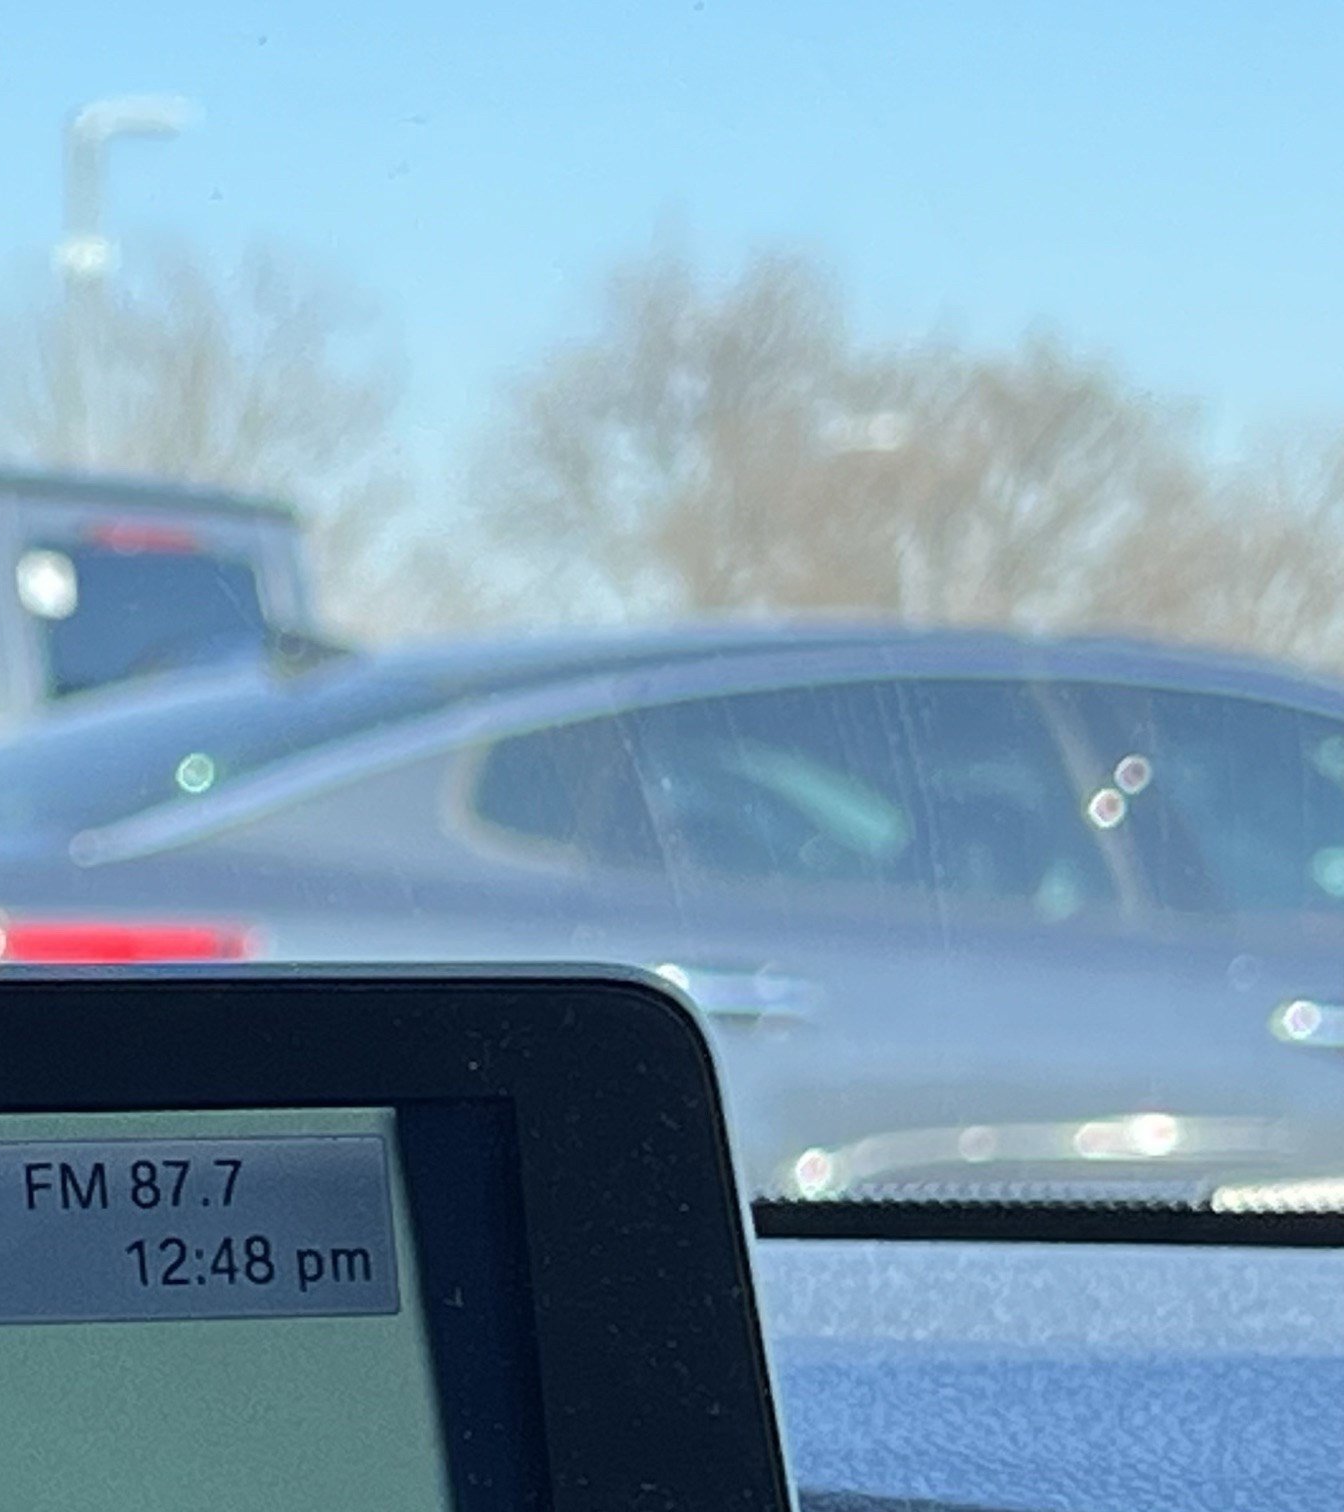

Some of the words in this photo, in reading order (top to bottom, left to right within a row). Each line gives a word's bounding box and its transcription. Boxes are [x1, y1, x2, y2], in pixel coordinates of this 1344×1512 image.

[24, 1161, 109, 1210] FM
[129, 1159, 243, 1209] 87.7
[125, 1235, 276, 1286] 12:48
[296, 1246, 372, 1292] pm
